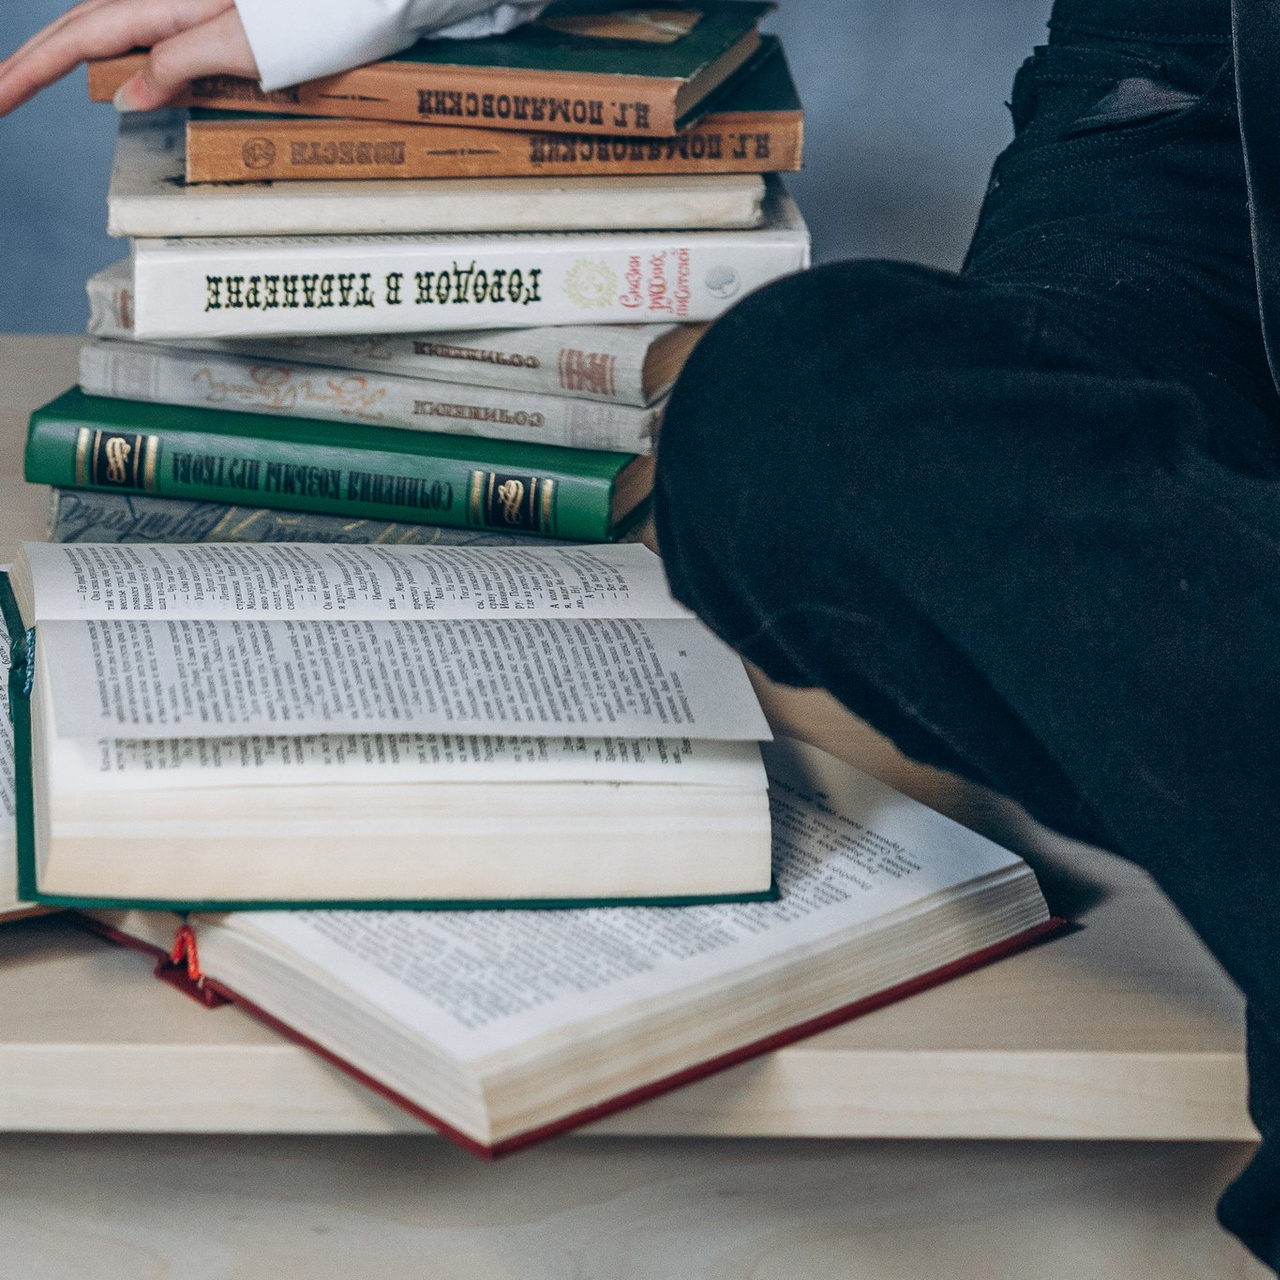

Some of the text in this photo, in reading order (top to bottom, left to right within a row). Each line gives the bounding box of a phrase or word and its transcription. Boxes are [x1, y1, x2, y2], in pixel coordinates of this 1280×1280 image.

[416, 88, 604, 126] ПОМЯЛОВСКИЙ
[290, 140, 406, 167] ПОВЕСТИ
[204, 260, 544, 313] ГОРОДОК В ТАБАКЕРКЕ
[618, 254, 644, 310] Сказки
[647, 250, 673, 315] русских
[673, 247, 693, 317] писателей
[413, 398, 546, 430] СОЧИНЕНИЯ
[170, 451, 454, 512] СОЧИНЕНИЯ КОЗЬМЫ ПРУТКОВА
